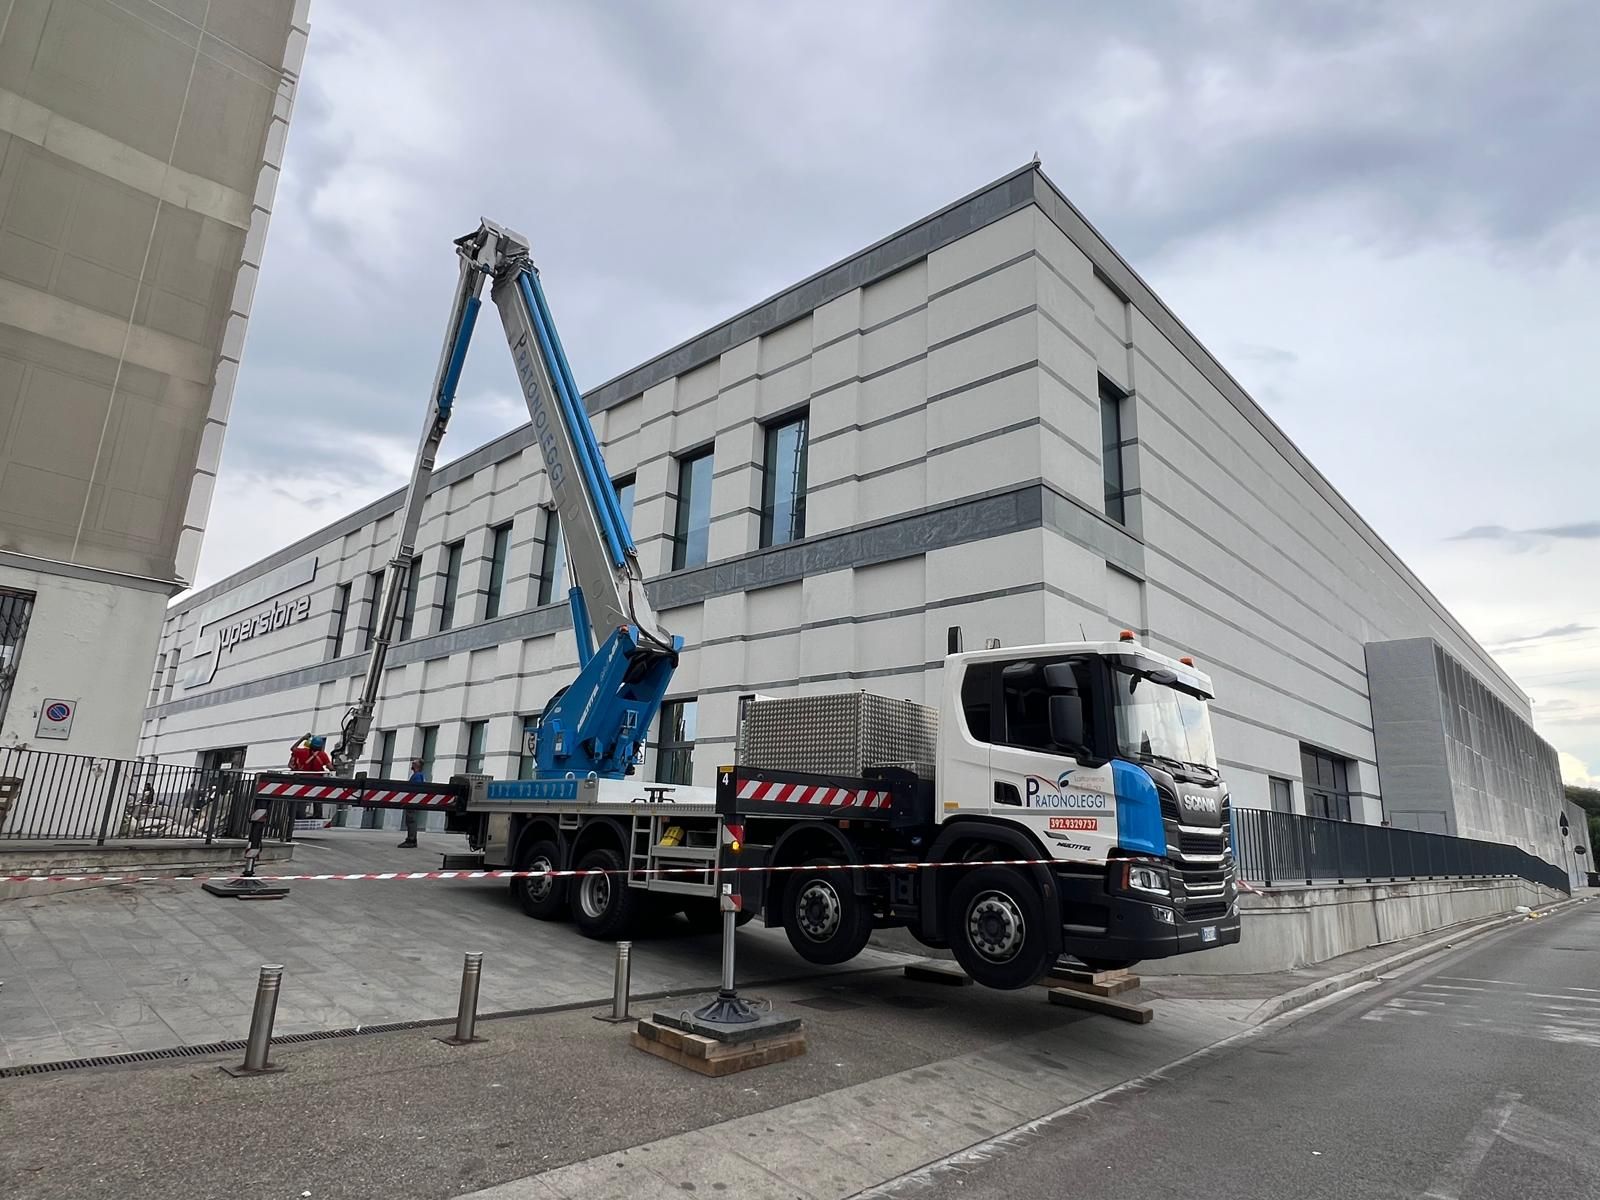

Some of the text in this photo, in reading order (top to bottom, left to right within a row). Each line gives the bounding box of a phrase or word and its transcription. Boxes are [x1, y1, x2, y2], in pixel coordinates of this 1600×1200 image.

[513, 329, 566, 491] PRATONOLEGGI
[183, 556, 319, 691] Superstore
[722, 772, 729, 786] 4
[1026, 777, 1106, 808] PRATONOLEGGI
[1184, 794, 1217, 813] SCANIA
[1050, 818, 1097, 830] 392.9329737
